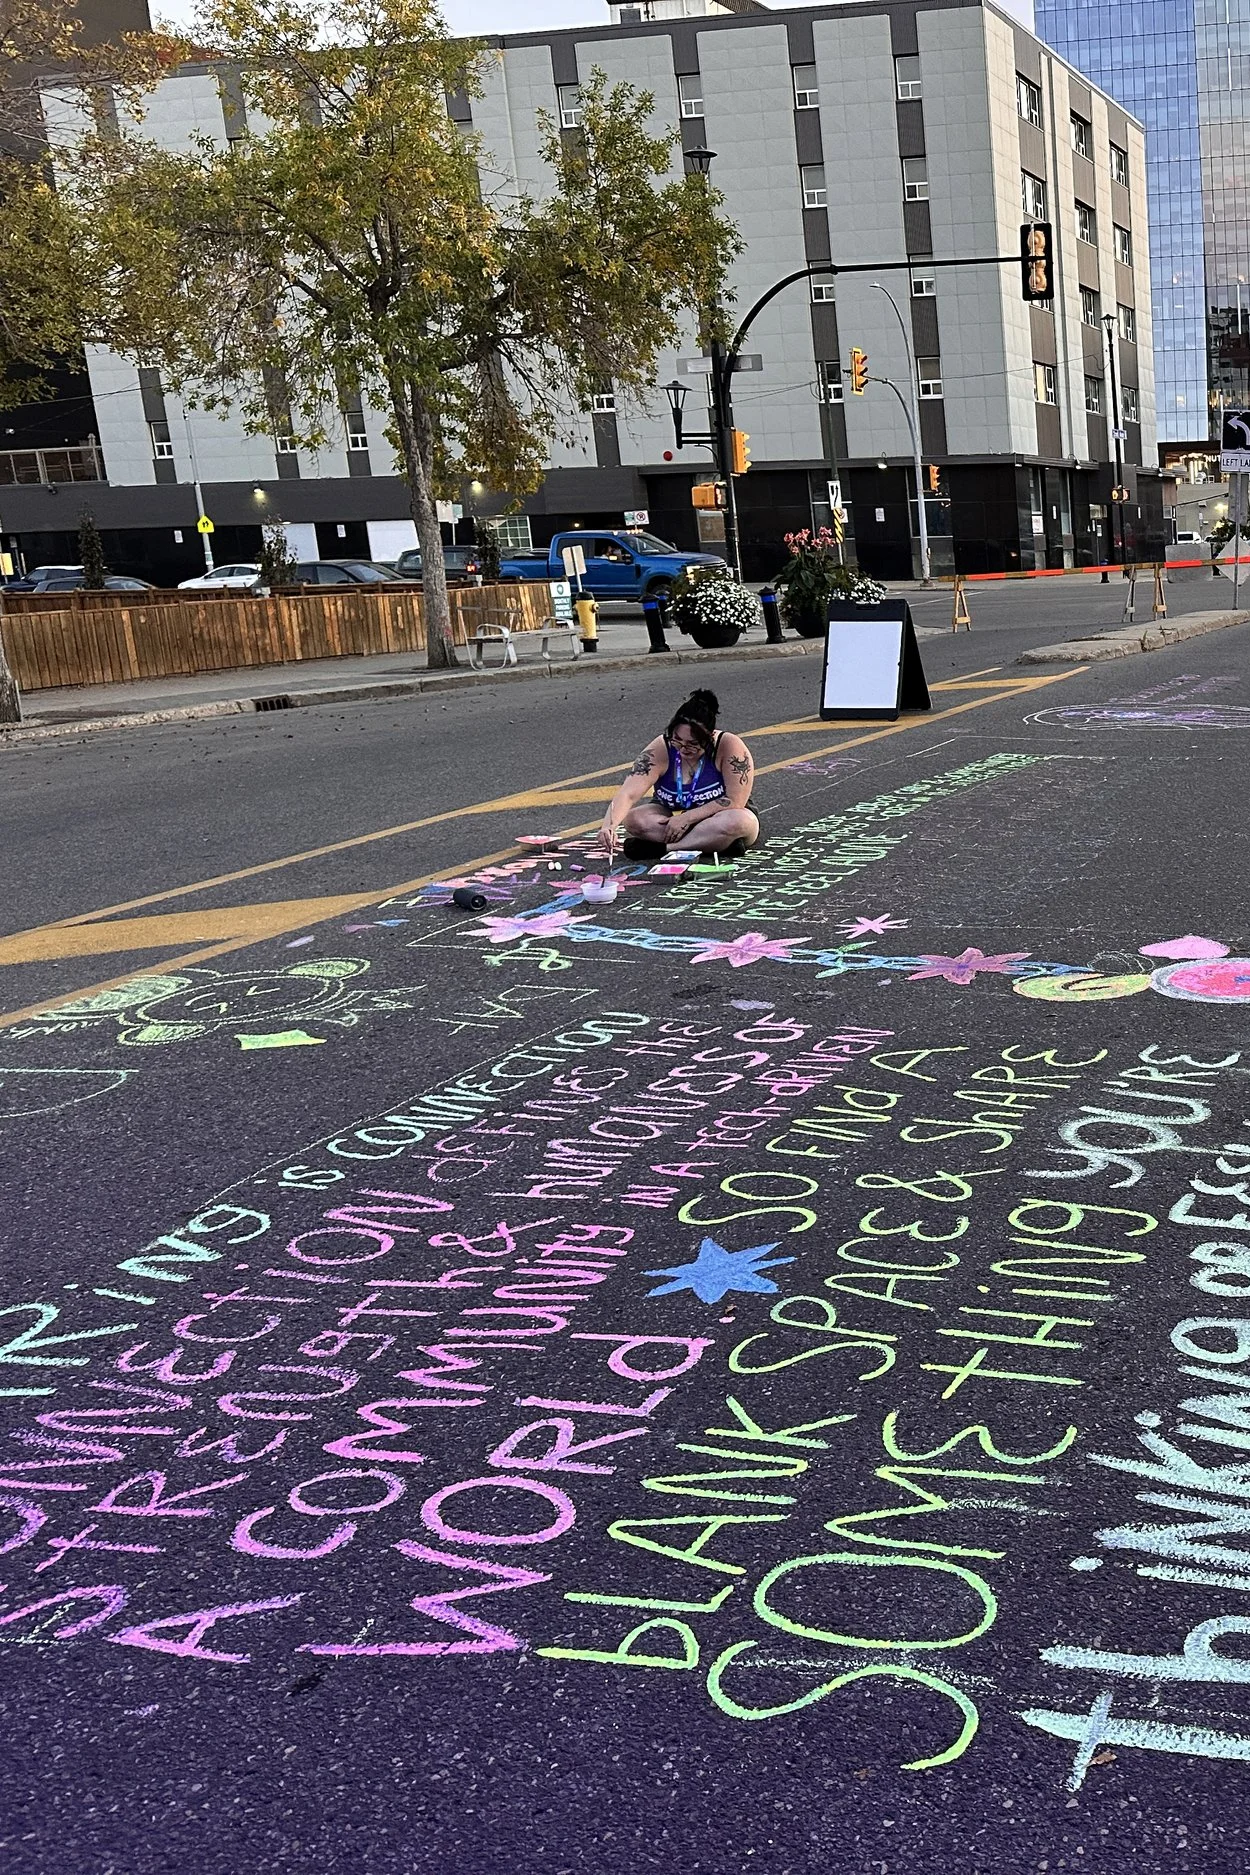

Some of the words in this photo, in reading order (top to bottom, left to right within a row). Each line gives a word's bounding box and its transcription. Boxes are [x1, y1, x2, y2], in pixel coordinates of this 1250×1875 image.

[1222, 458, 1238, 466] LEFT
[657, 789, 673, 802] ONE
[676, 785, 724, 803] IECTION
[326, 1011, 651, 1160] CONNECTION
[427, 1216, 566, 1257] &
[733, 1012, 813, 1044] OF
[678, 1171, 819, 1233] SO
[869, 1044, 968, 1083] A
[728, 1205, 970, 1381] SPACE
[856, 1168, 981, 1202] &
[108, 1592, 305, 1664] A
[651, 1161, 720, 1179] A
